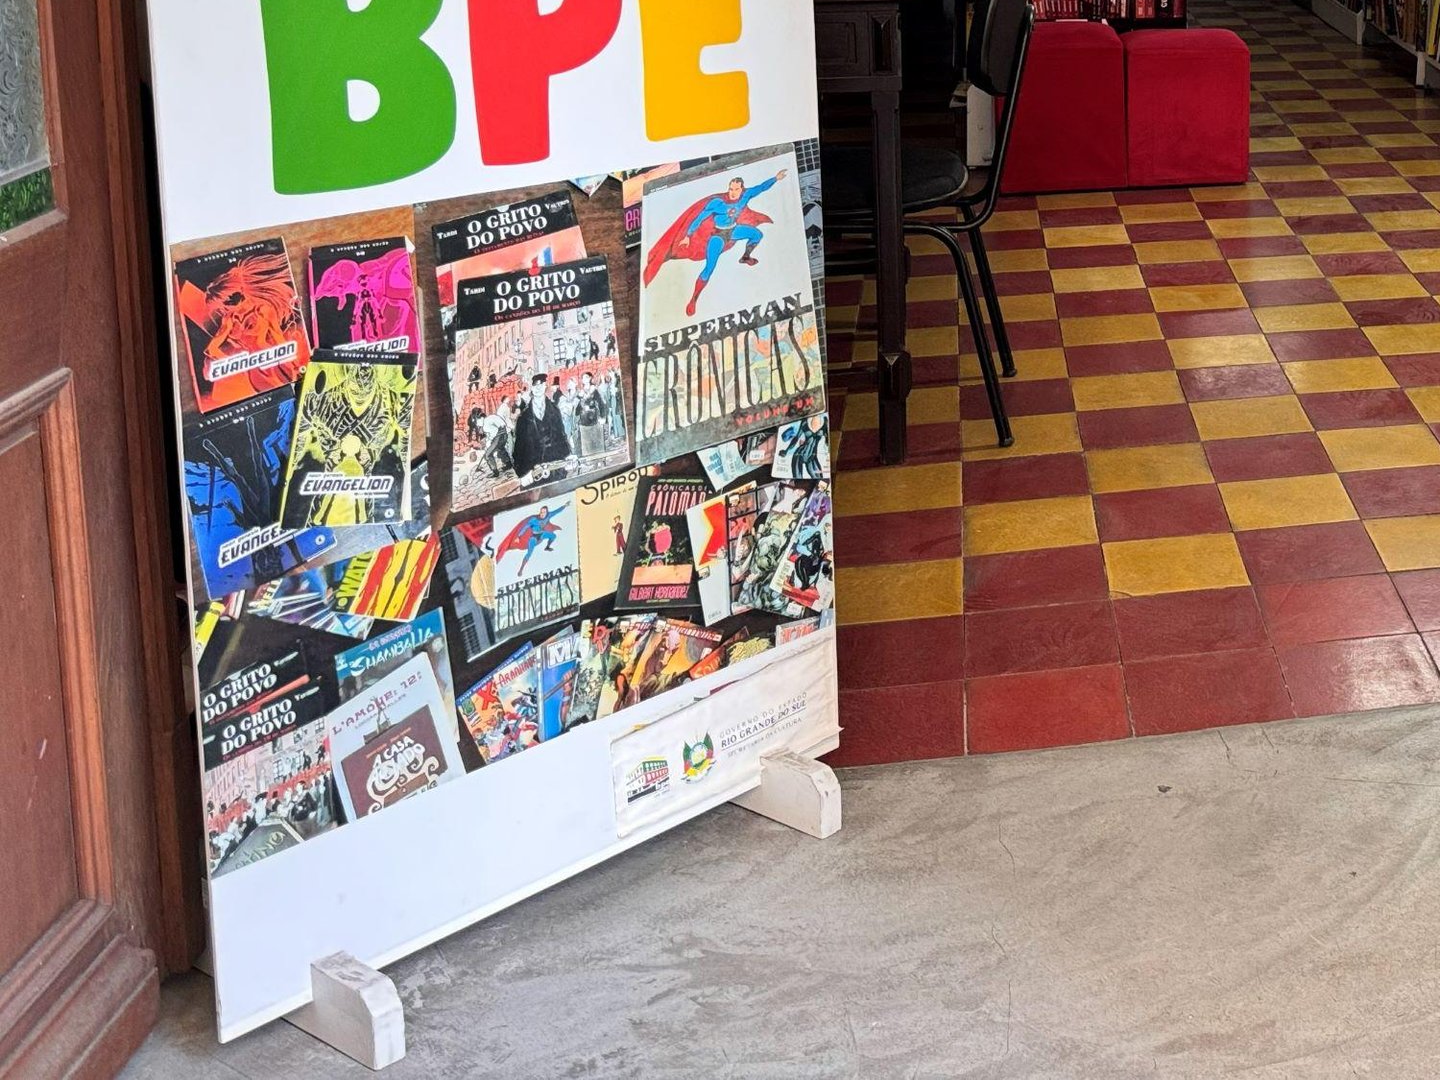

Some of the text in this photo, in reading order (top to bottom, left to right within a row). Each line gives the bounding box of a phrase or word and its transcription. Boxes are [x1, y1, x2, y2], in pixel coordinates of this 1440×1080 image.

[466, 216, 548, 249] DO POVO
[468, 204, 541, 234] O GRITO
[493, 284, 581, 314] DO POVO
[497, 270, 576, 296] O GRITO
[645, 292, 804, 353] SUPERMAN
[212, 342, 296, 379] EVANGELION
[640, 315, 812, 440] CRÔNICAS
[303, 477, 391, 493] EVANGELION
[580, 466, 648, 506] SPIROU
[497, 564, 574, 597] SUPERMAN
[202, 673, 278, 723] DO POVO
[203, 663, 272, 708] O GRITO
[221, 710, 297, 756] DO POVO
[223, 698, 293, 739] O GRITO
[721, 733, 737, 749] RIO
[739, 716, 777, 740] GRANDE
